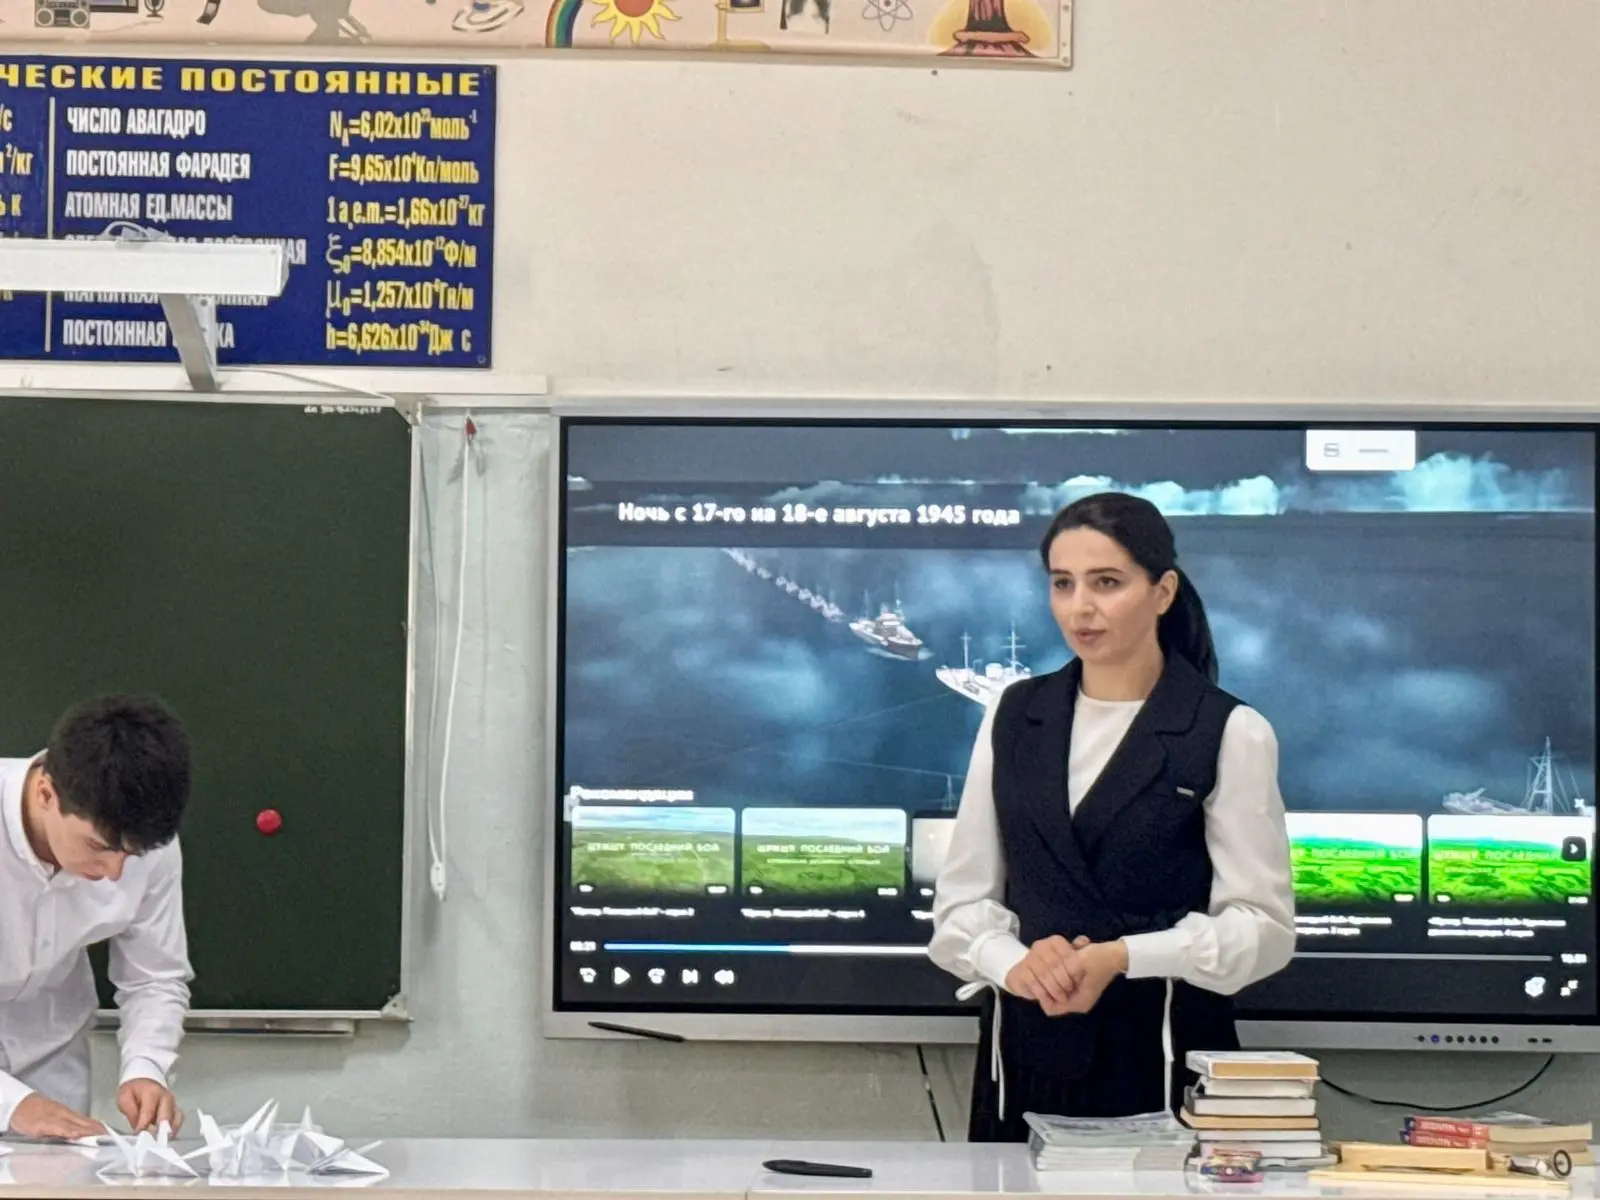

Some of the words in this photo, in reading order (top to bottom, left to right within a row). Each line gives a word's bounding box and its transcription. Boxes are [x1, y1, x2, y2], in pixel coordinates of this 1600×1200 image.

[180, 67, 480, 96] ПОСТОЯННЫЕ
[66, 106, 121, 133] ЧИСЛО
[126, 108, 206, 139] АВАГАДРО
[66, 150, 170, 177] ПОСТОЯННАЯ
[175, 152, 251, 182] ФАРАДЕЯ
[64, 191, 140, 219] АТОМНАЯ
[146, 193, 233, 223] ЕД.МАССЫ
[63, 319, 167, 346] ПОСТОЯННАЯ
[618, 502, 671, 522] Ночь
[674, 506, 687, 522] с
[692, 502, 746, 522] 17-го
[750, 507, 776, 522] на
[782, 503, 829, 523] 18-е
[832, 507, 911, 528] августа
[916, 504, 967, 524] 1945
[971, 509, 1021, 527] года
